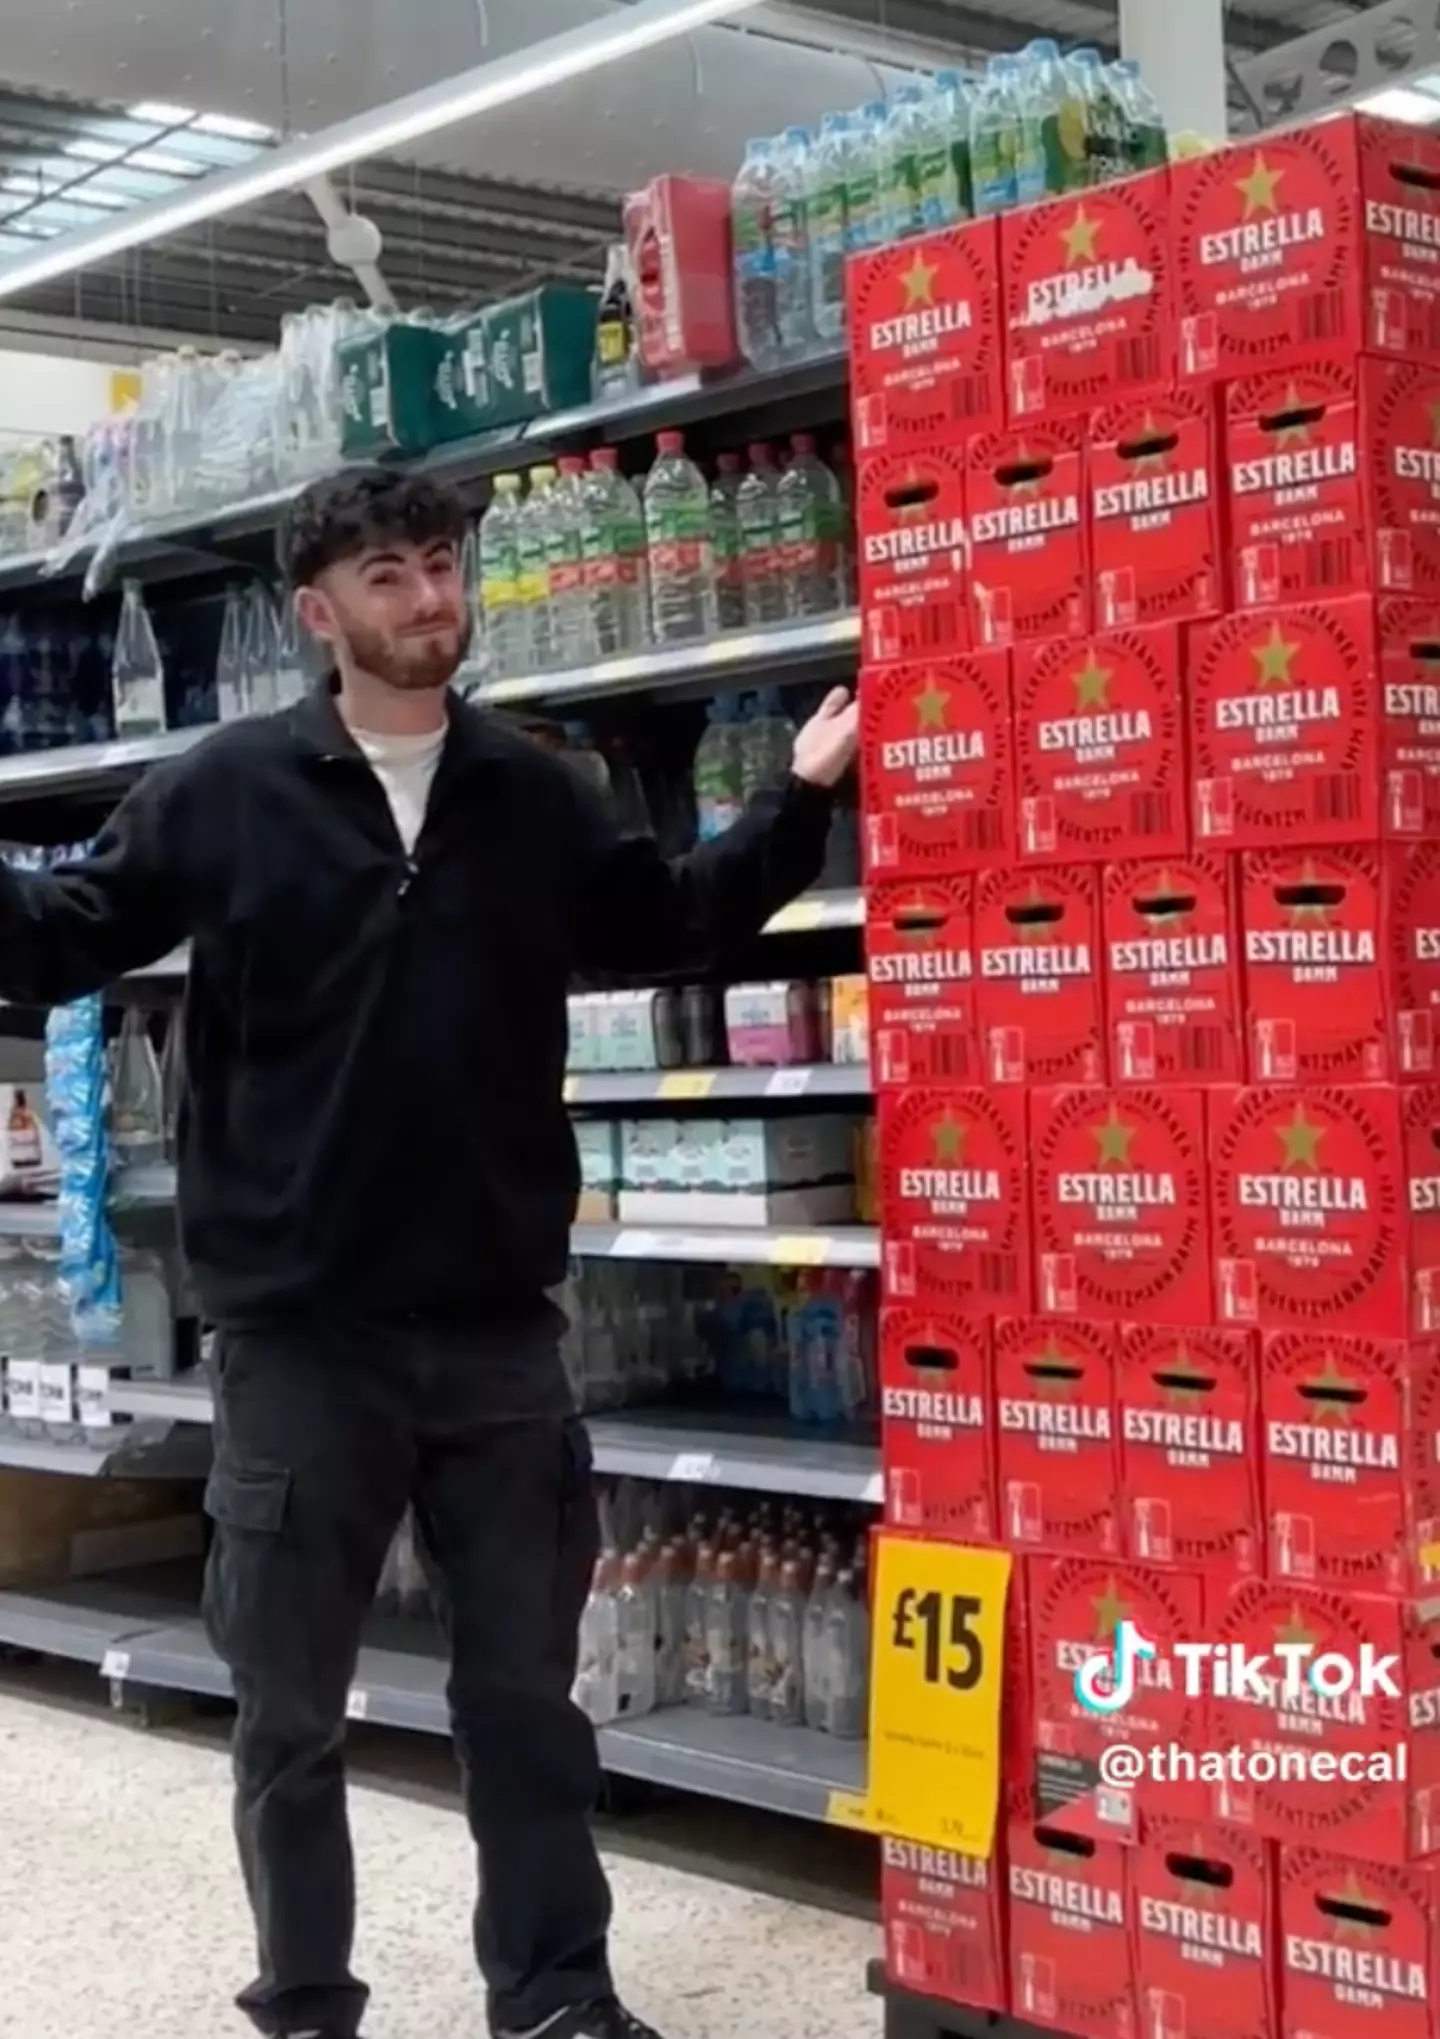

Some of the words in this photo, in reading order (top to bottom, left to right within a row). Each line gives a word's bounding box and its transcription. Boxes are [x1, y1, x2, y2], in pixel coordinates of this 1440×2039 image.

[1200, 208, 1324, 264] ESTRELLA
[870, 301, 972, 350] ESTRELLA
[1232, 442, 1355, 493] ESTRELLA
[1094, 469, 1208, 518] ESTRELLA
[865, 518, 965, 563] ESTRELLA
[972, 496, 1078, 541] ESTRELLA
[1038, 710, 1151, 749] ESTRELLA
[1215, 686, 1340, 729] ESTRELLA
[882, 731, 984, 769] ESTRELLA
[870, 950, 972, 982] ESTRELLA
[981, 945, 1090, 977] ESTRELLA
[1111, 934, 1227, 971] ESTRELLA
[1246, 930, 1375, 963] ESTRELLA
[900, 1169, 1000, 1200] ESTRELLA
[1058, 1173, 1175, 1204] ESTRELLA
[1238, 1174, 1367, 1209] ESTRELLA
[883, 1388, 984, 1426] ESTRELLA
[1000, 1399, 1110, 1440] ESTRELLA
[1124, 1409, 1243, 1453] ESTRELLA
[1267, 1420, 1399, 1468] ESTRELLA
[892, 1588, 984, 1691] £15
[1237, 1672, 1366, 1725] STRELLA
[883, 1836, 987, 1887] ESTRELLA
[1009, 1864, 1123, 1923] ESTRELLA
[1139, 1896, 1262, 1957] ESTRELLA
[1285, 1935, 1426, 1998] ESTRELLA
